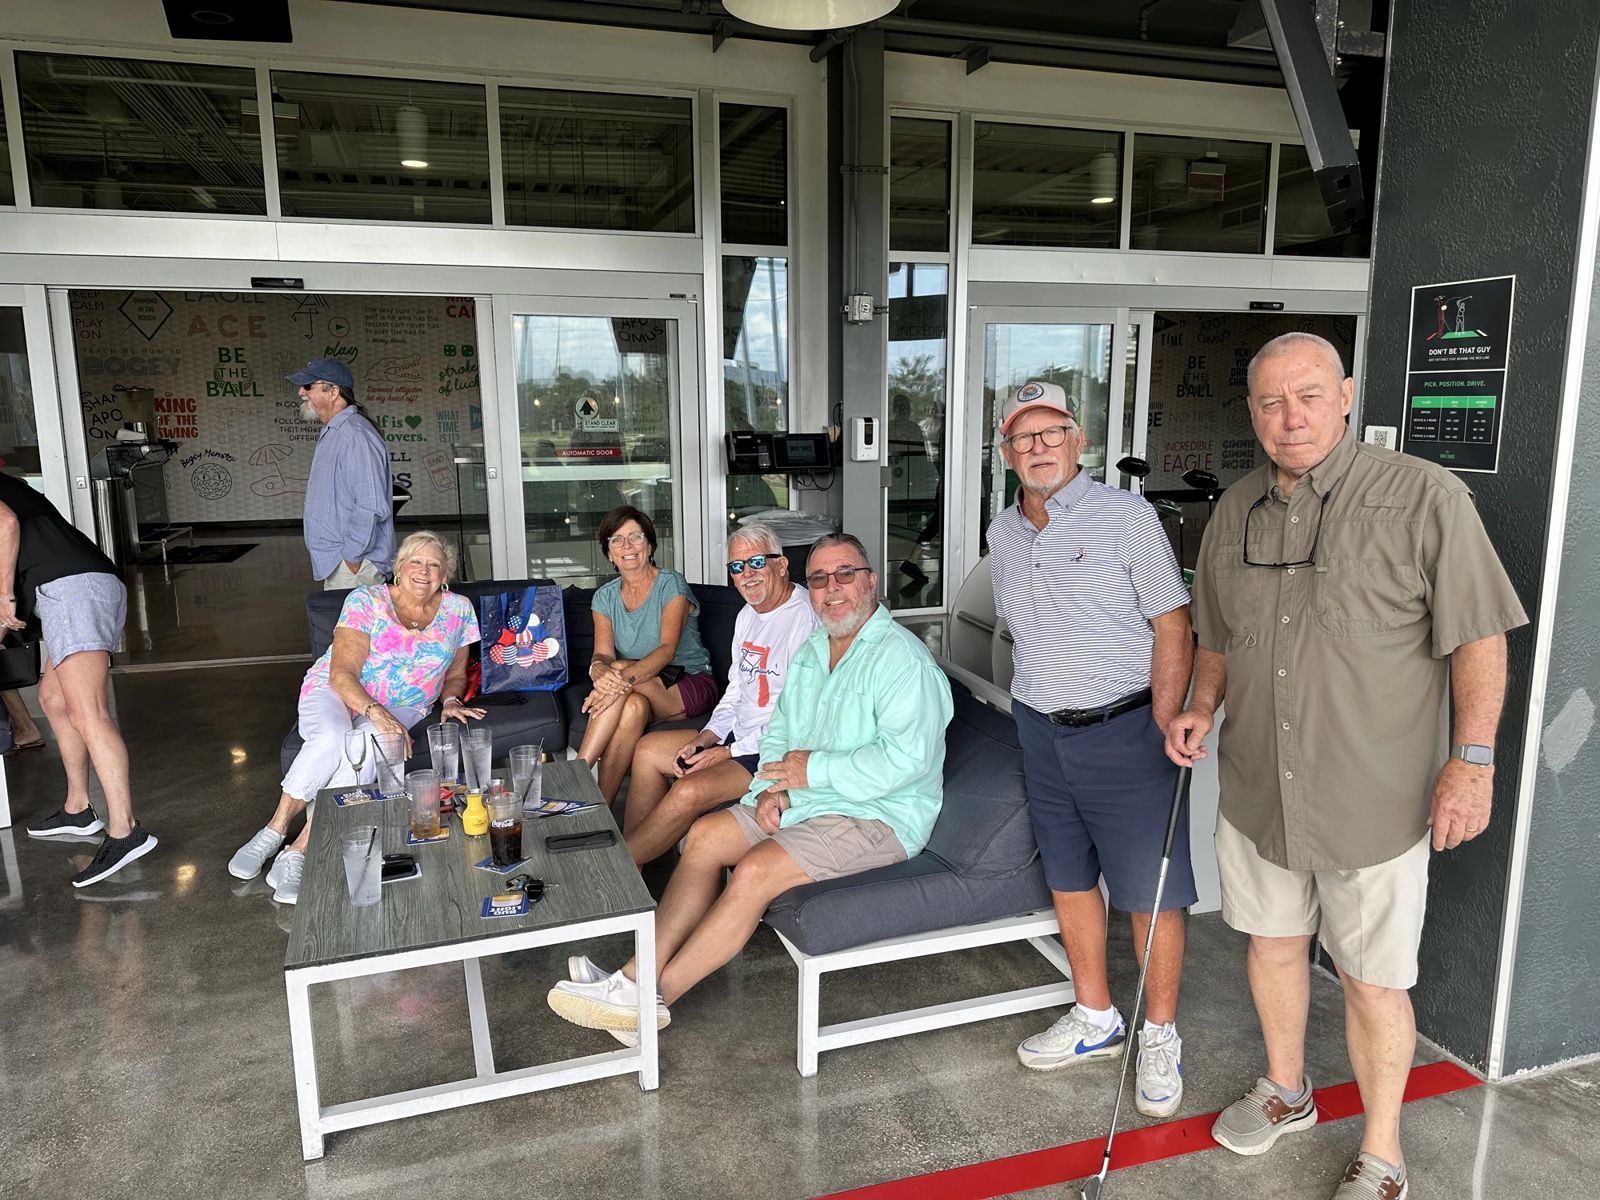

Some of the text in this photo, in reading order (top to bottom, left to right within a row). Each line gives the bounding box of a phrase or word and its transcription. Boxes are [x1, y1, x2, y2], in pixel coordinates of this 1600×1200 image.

[72, 301, 104, 310] CALM
[75, 319, 104, 328] PLAY
[187, 315, 267, 338] ACE
[80, 330, 102, 339] ON
[1161, 334, 1184, 347] TIME
[217, 347, 246, 363] BE
[324, 342, 358, 364] play
[83, 357, 182, 376] BOGEY
[1188, 355, 1207, 370] BE
[219, 367, 248, 378] THE
[1186, 373, 1208, 383] THE
[206, 381, 265, 398] BALL
[1176, 383, 1213, 398] BALL
[154, 398, 197, 413] KING
[175, 415, 198, 425] THE
[437, 410, 459, 421] WHAT
[392, 416, 403, 429] is
[438, 421, 460, 433] TIME
[1164, 440, 1214, 453] INCREDIBLE
